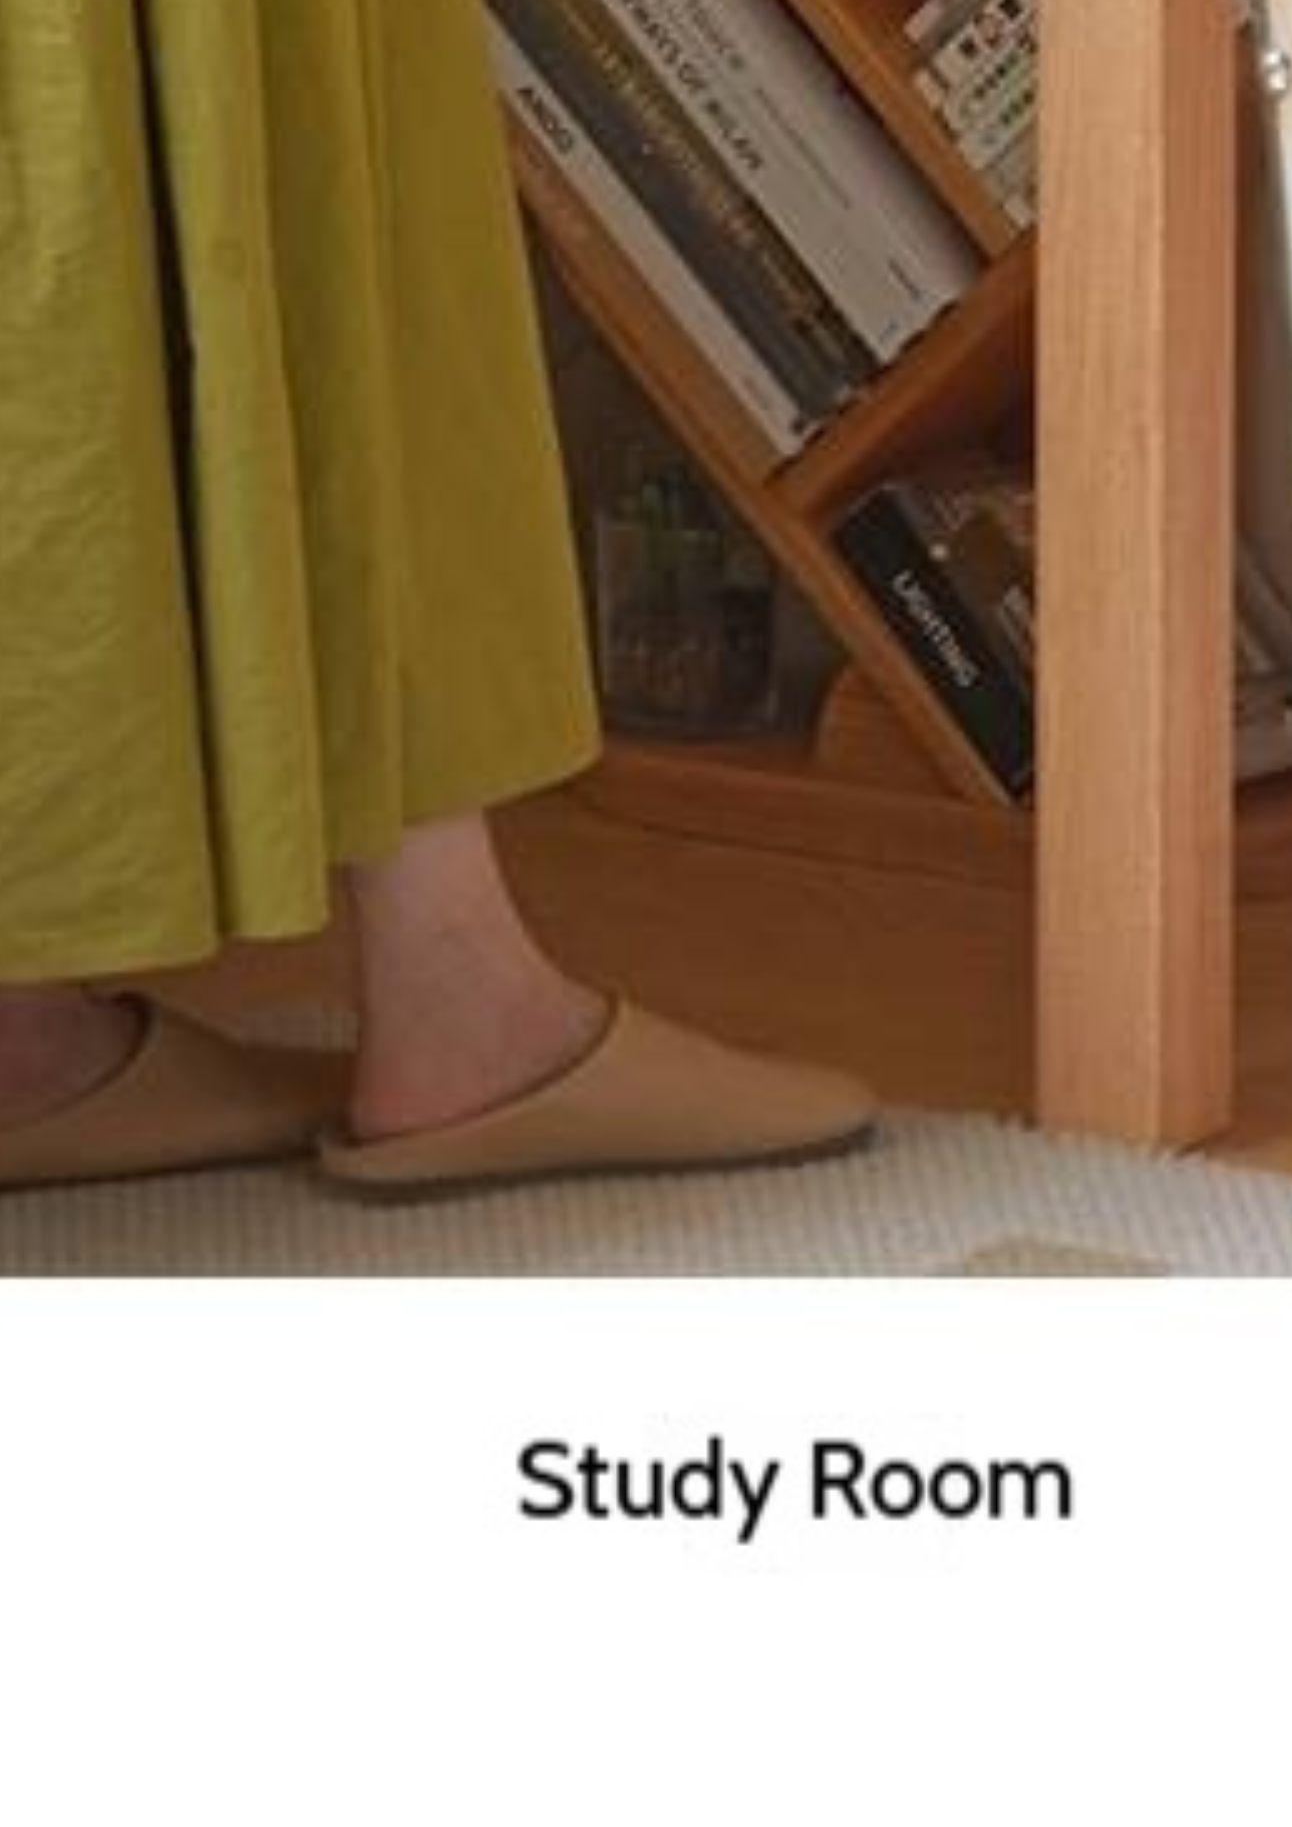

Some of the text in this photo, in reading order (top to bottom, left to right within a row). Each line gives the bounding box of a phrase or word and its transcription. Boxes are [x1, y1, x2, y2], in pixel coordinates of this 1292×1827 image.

[677, 60, 707, 95] OF
[515, 86, 575, 157] ANDO
[891, 567, 981, 689] LIGHTING
